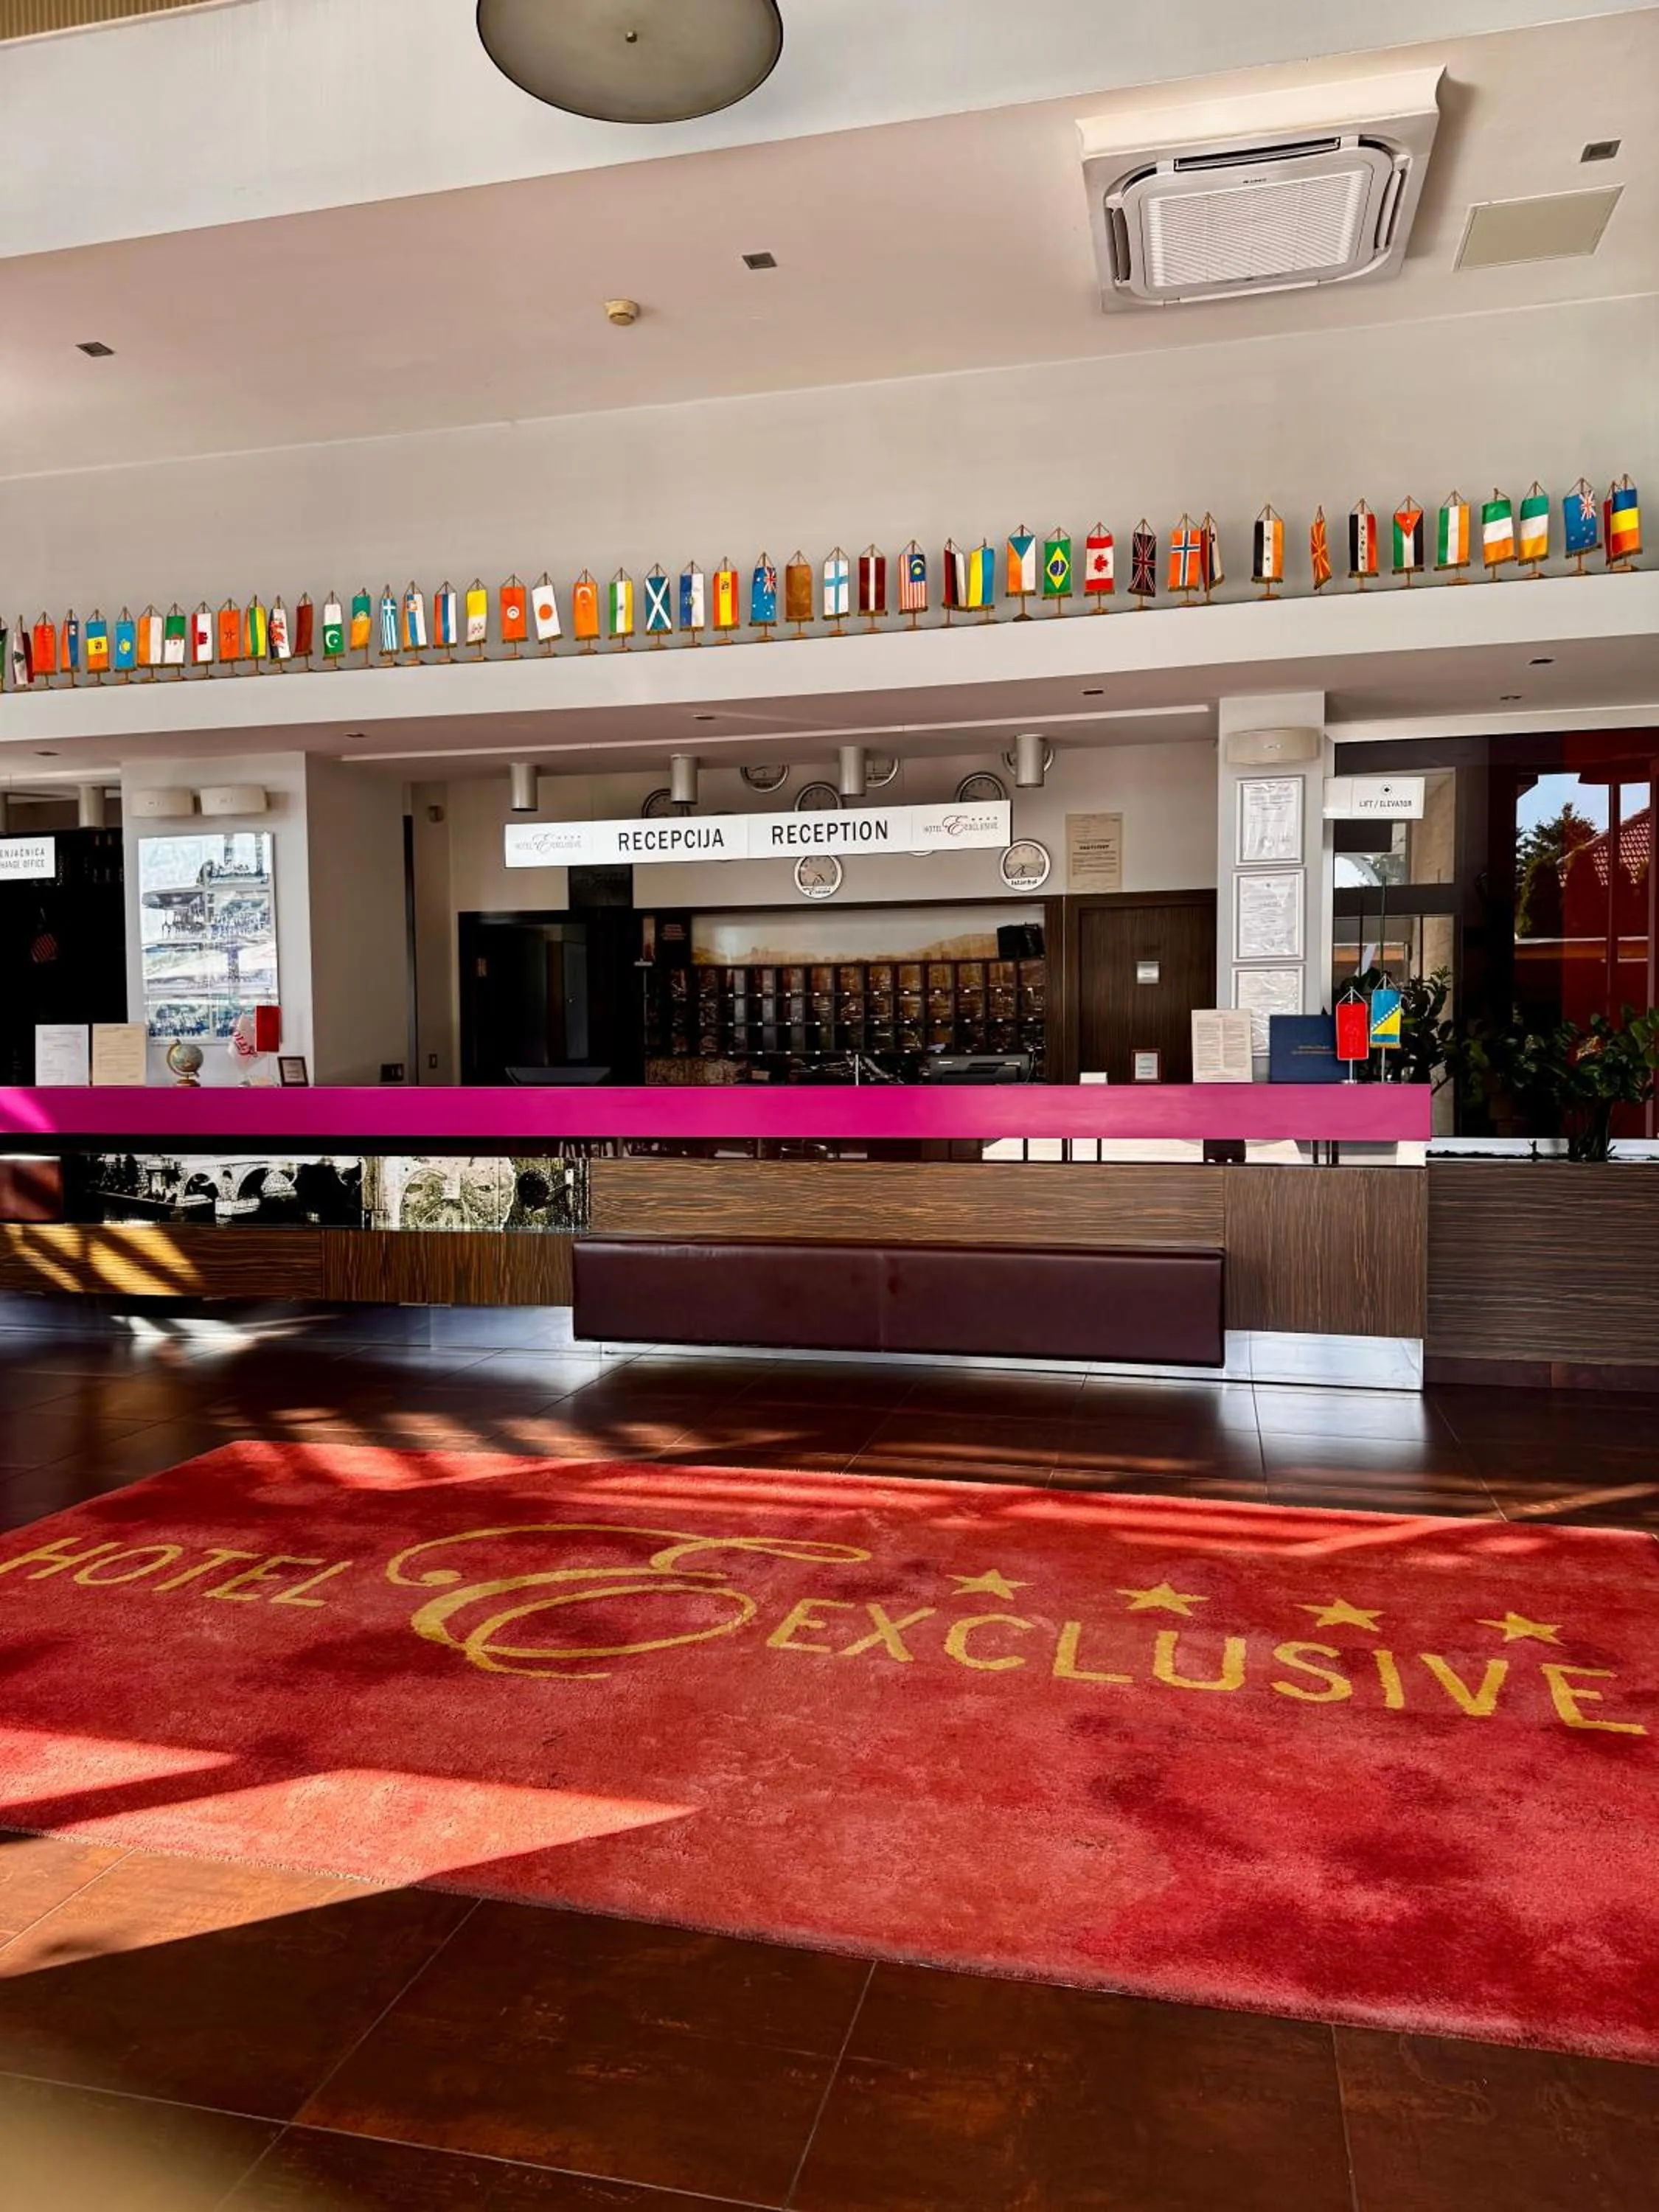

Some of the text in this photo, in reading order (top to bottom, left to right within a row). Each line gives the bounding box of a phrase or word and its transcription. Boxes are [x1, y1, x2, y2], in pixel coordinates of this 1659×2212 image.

[1359, 800, 1373, 808] LIFT
[619, 820, 888, 851] RECEPCIJA RECEPTION
[0, 1537, 353, 1607] HOTEL
[766, 1597, 1650, 1735] EXCLUSIVE
